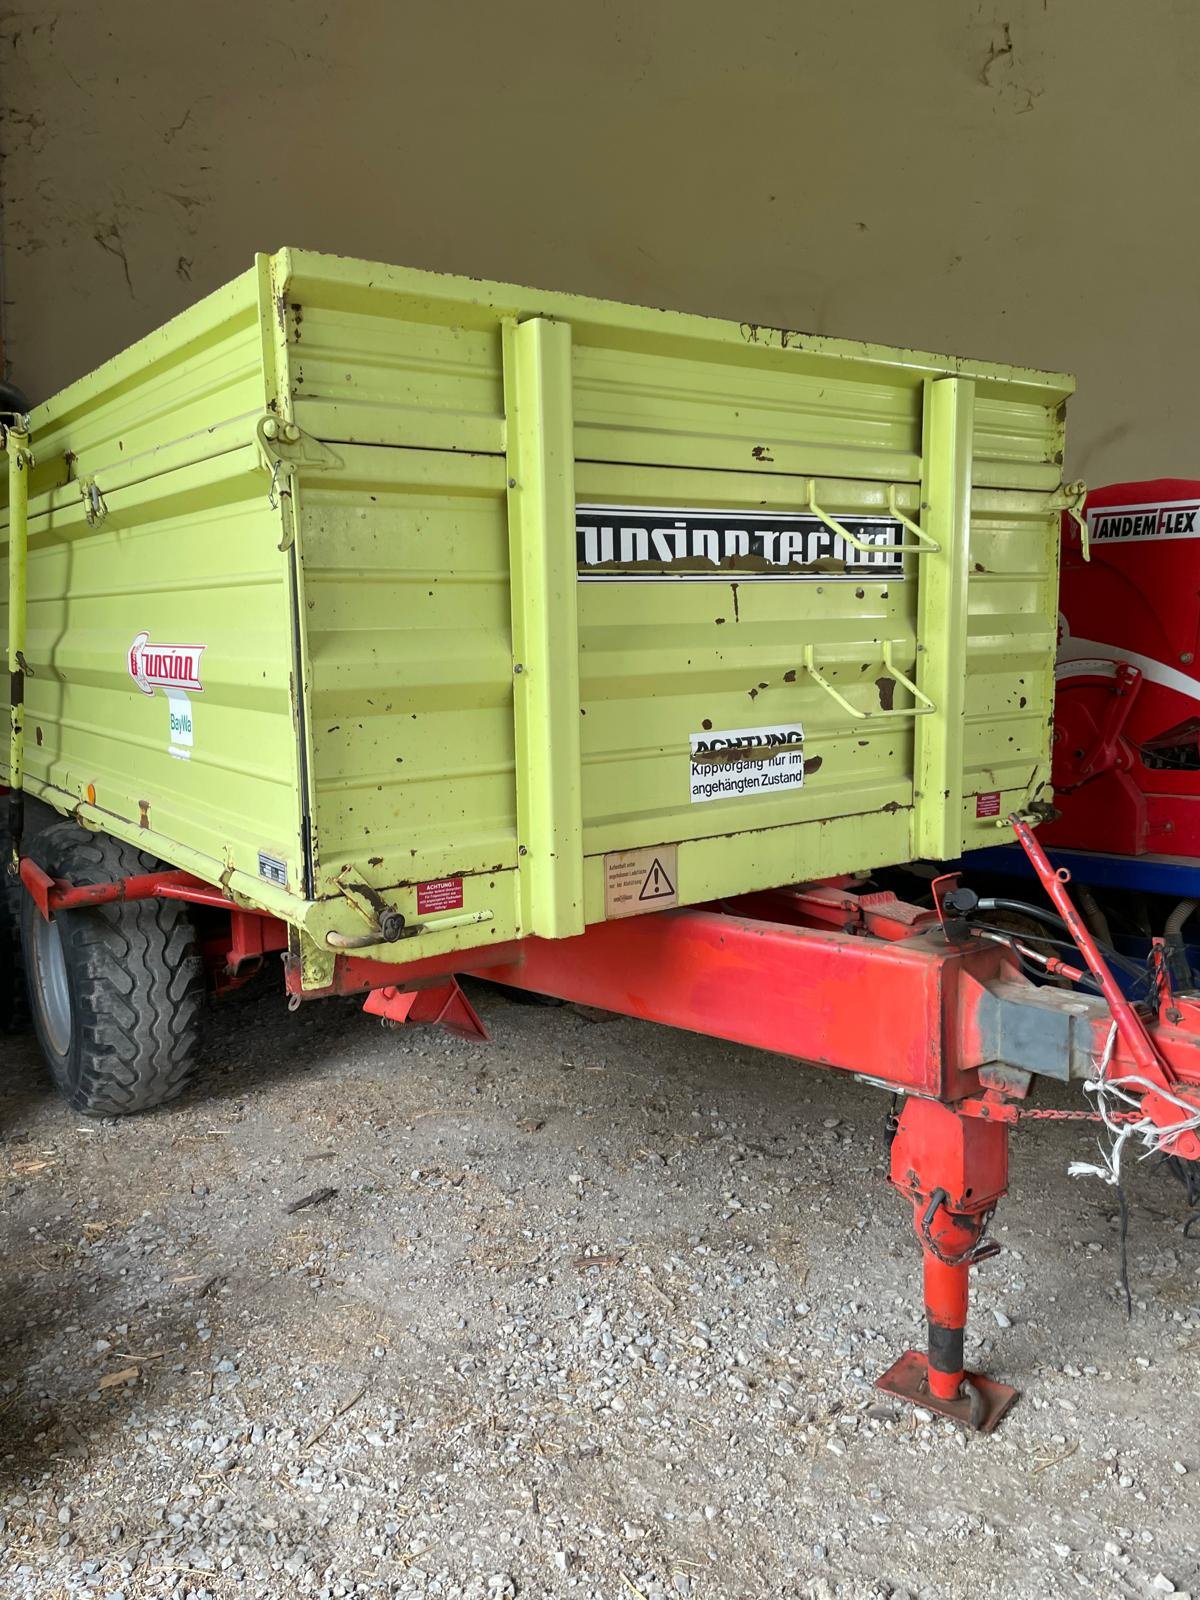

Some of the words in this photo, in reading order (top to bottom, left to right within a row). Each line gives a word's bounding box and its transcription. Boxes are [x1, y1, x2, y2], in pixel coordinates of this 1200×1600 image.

[170, 713, 192, 735] BayWa
[691, 759, 764, 777] Kippvorgang
[768, 755, 786, 767] nur
[789, 752, 802, 765] im
[692, 776, 761, 797] angehängten
[761, 770, 802, 787] Zustand
